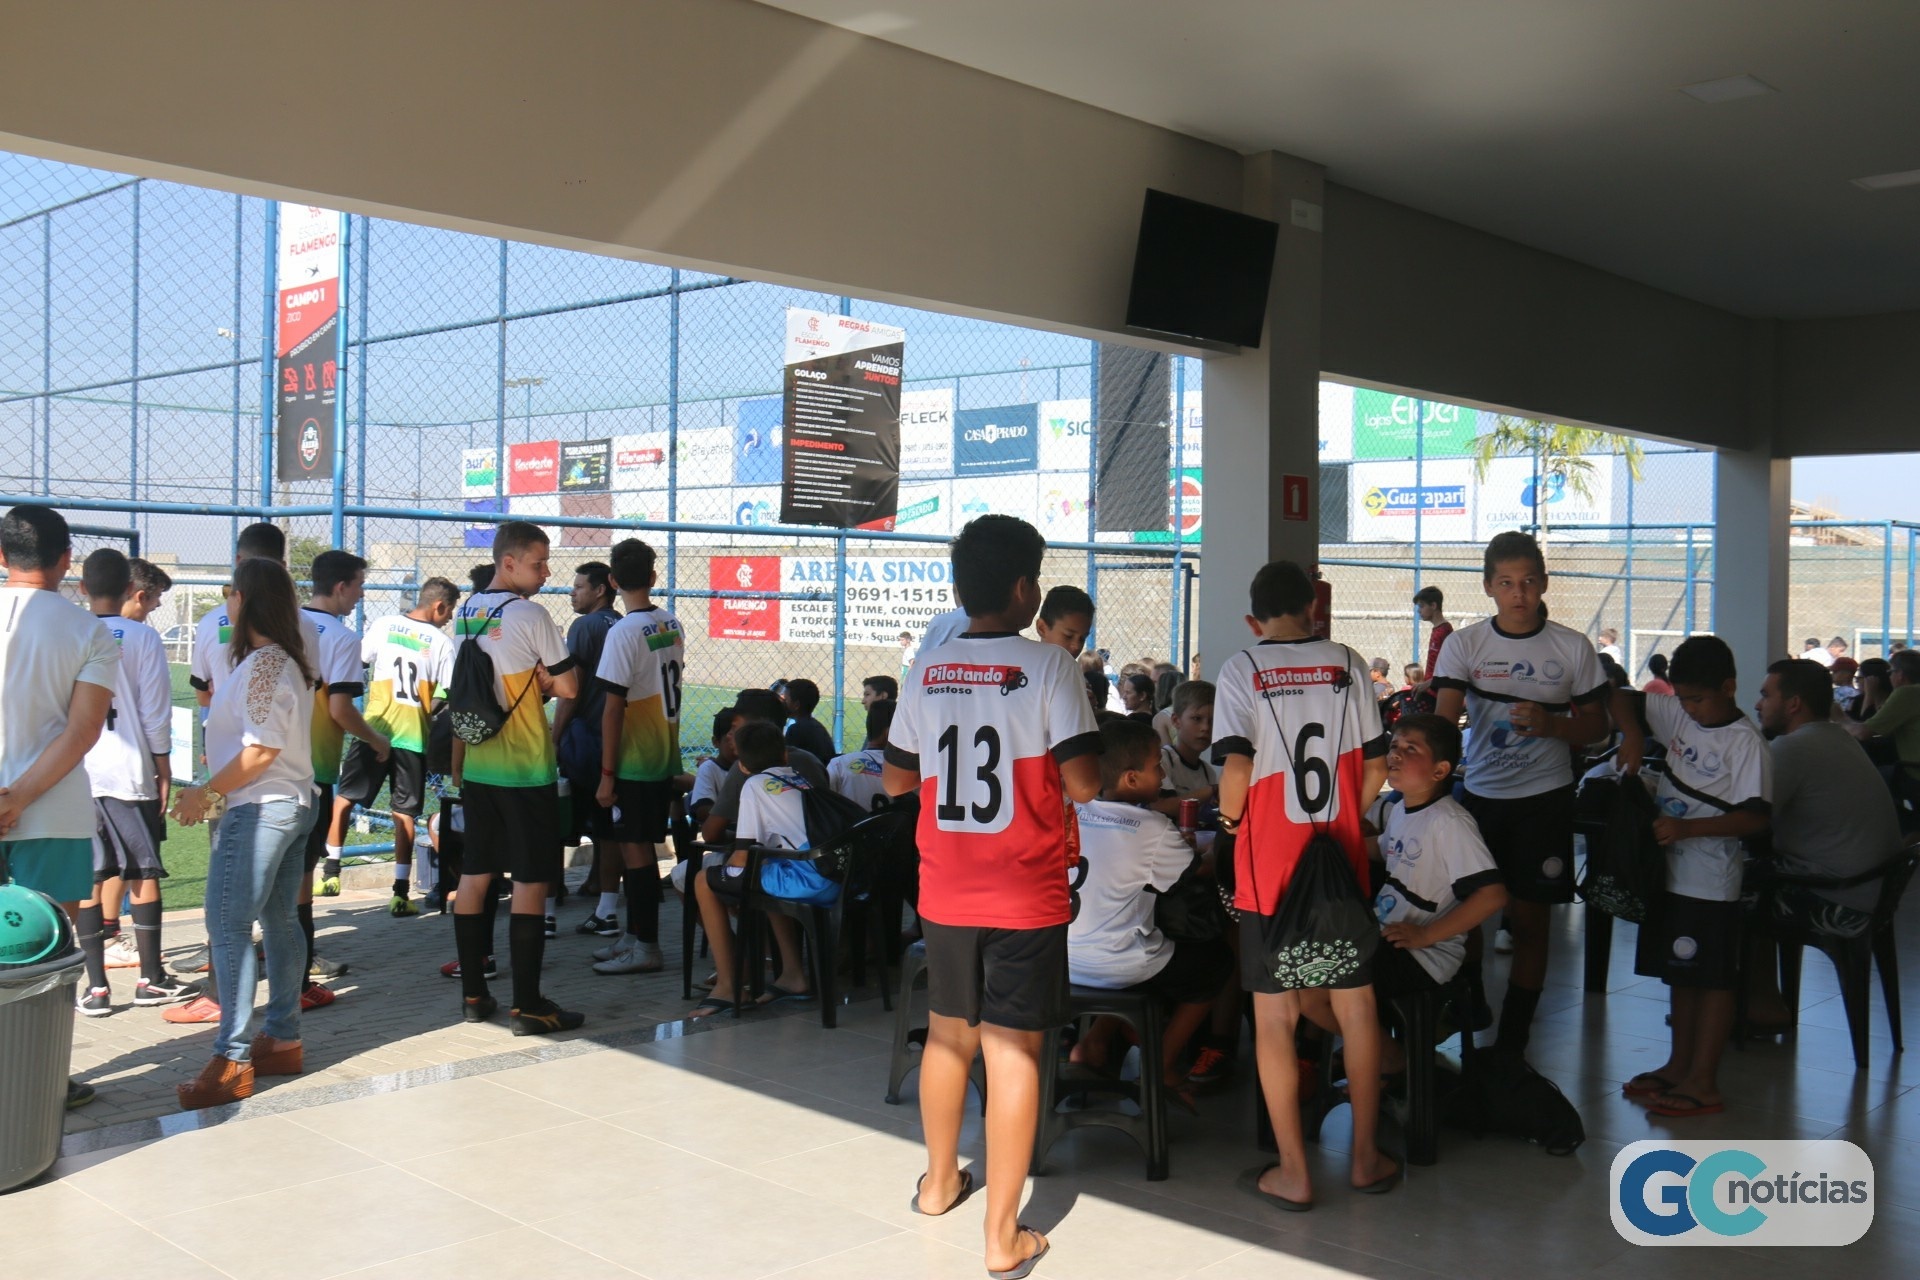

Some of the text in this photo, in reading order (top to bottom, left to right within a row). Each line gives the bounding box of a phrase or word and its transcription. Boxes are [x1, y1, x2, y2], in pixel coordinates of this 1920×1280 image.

[290, 232, 337, 256] FLAMENGO
[285, 287, 326, 309] CAMPO 1
[838, 319, 901, 340] REGRAS AMIGAS
[794, 336, 831, 348] FLAMENGO
[871, 353, 900, 367] VAMOS
[794, 368, 828, 381] GOLAÇO
[854, 360, 900, 377] APRENDER
[863, 371, 899, 386] JUNTOS!
[900, 409, 949, 426] FLECK
[964, 424, 1028, 442] CASA PRADO
[790, 438, 845, 452] IMPEDIMENTO
[790, 560, 876, 582] ARENA
[846, 586, 948, 602] 9691-1515
[723, 599, 768, 611] FLAMENGO
[791, 603, 828, 613] ESCALE
[831, 605, 852, 614] SU
[855, 605, 887, 616] TIME,
[791, 616, 798, 624] A
[801, 616, 848, 626] TORCIA
[852, 618, 859, 626] E
[862, 618, 901, 628] VENHA
[789, 628, 826, 639] Futebol
[828, 629, 864, 642] Siety
[870, 632, 902, 643] Squas
[927, 666, 1003, 683] Pilotando
[1259, 667, 1333, 688] Pilotando
[926, 686, 973, 695] Gostoso
[1262, 687, 1305, 699] Gostoso
[937, 724, 1002, 824] 13
[1293, 722, 1331, 815] 6
